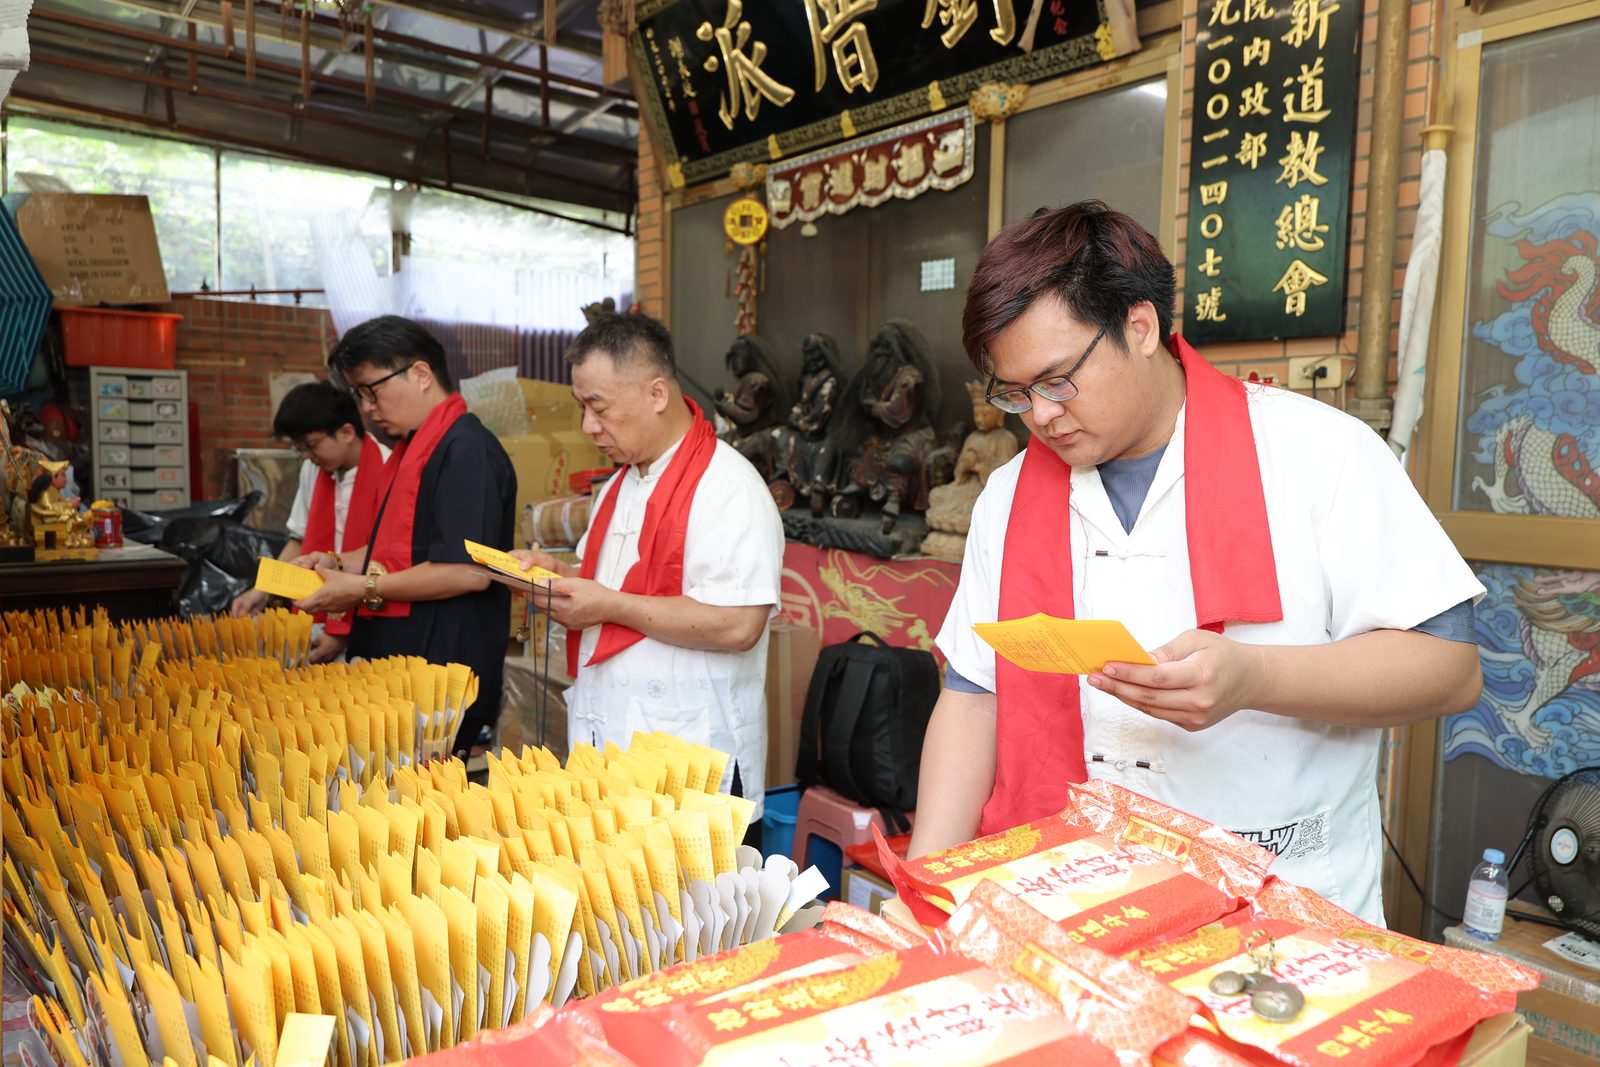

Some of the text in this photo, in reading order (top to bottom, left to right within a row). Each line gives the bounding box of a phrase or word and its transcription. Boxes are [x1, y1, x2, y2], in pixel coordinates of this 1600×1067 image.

[1272, 0, 1341, 317] 新道教總會
